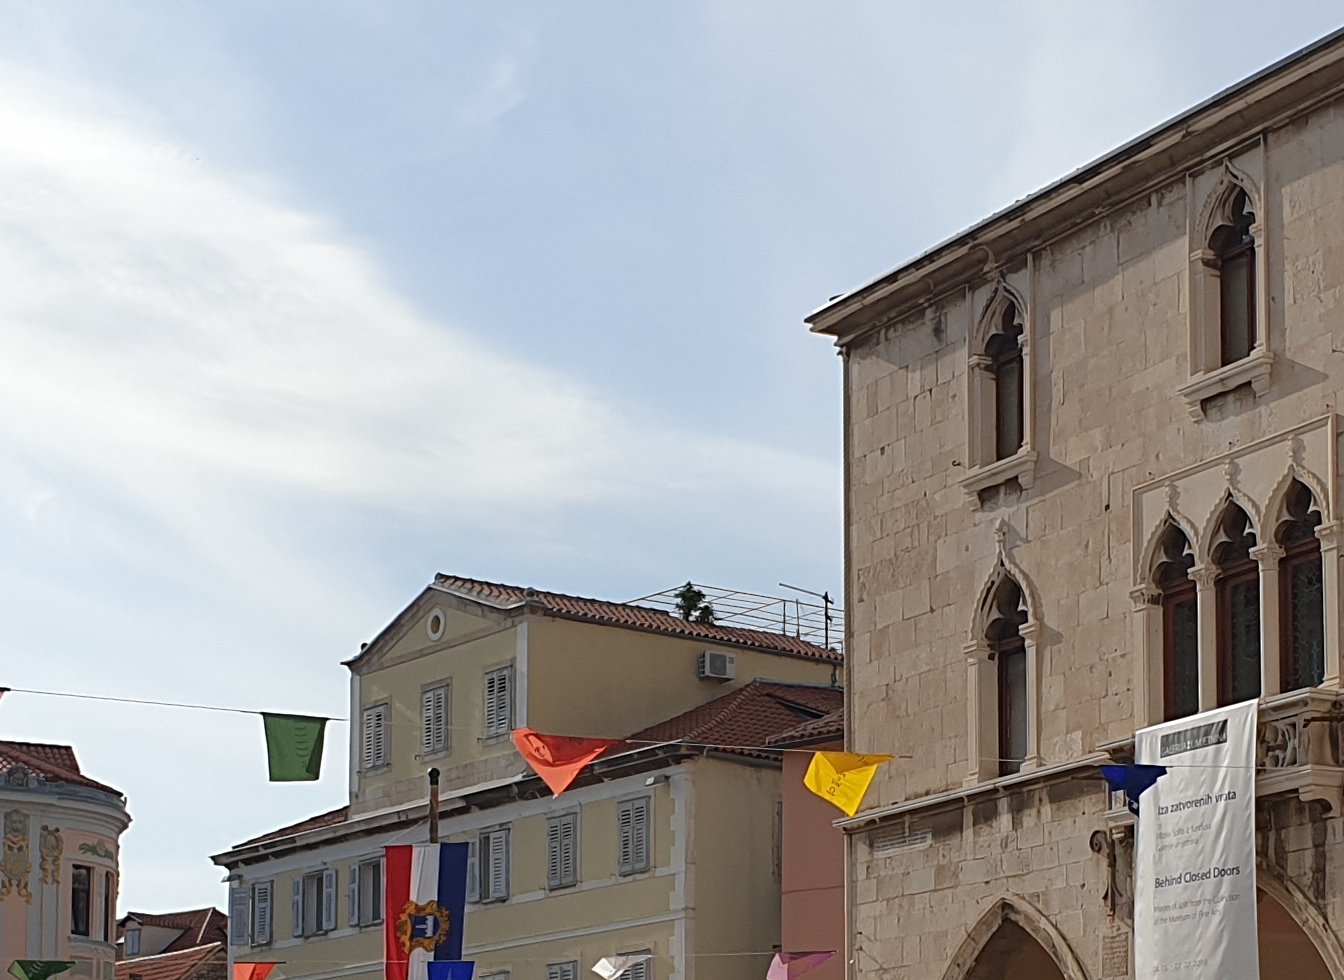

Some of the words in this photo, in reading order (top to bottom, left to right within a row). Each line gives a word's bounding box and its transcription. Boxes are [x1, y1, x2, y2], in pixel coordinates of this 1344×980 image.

[1157, 804, 1169, 816] Iza
[1170, 793, 1213, 814] zatvorenih
[1215, 790, 1237, 803] vrata
[1154, 873, 1182, 889] Behind
[1183, 867, 1212, 884] Closed
[1213, 865, 1241, 879] Doors
